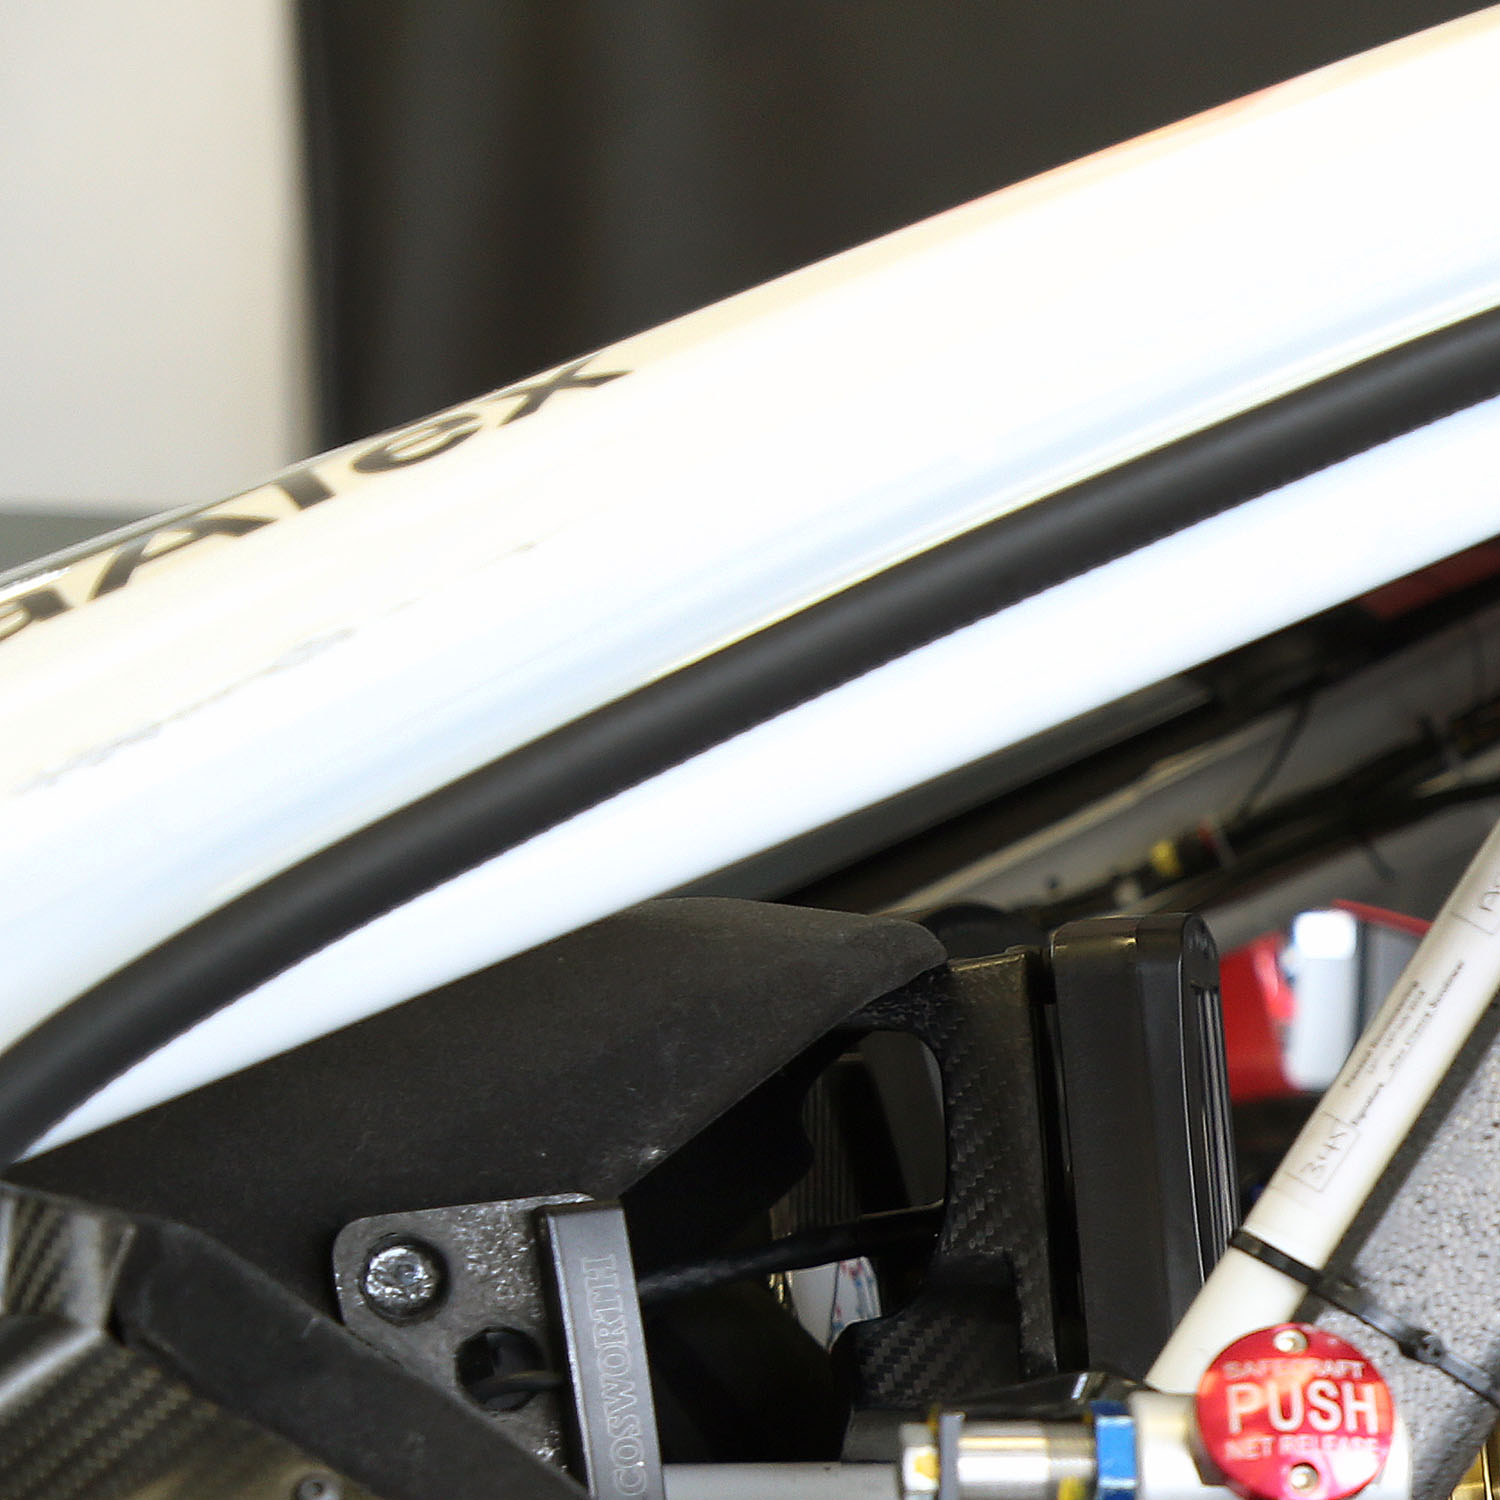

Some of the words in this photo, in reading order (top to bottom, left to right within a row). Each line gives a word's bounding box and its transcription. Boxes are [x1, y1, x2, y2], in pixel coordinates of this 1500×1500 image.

[582, 1253, 647, 1497] COSWORTH
[1226, 1378, 1380, 1435] PUSH
[1224, 1436, 1276, 1460] NET
